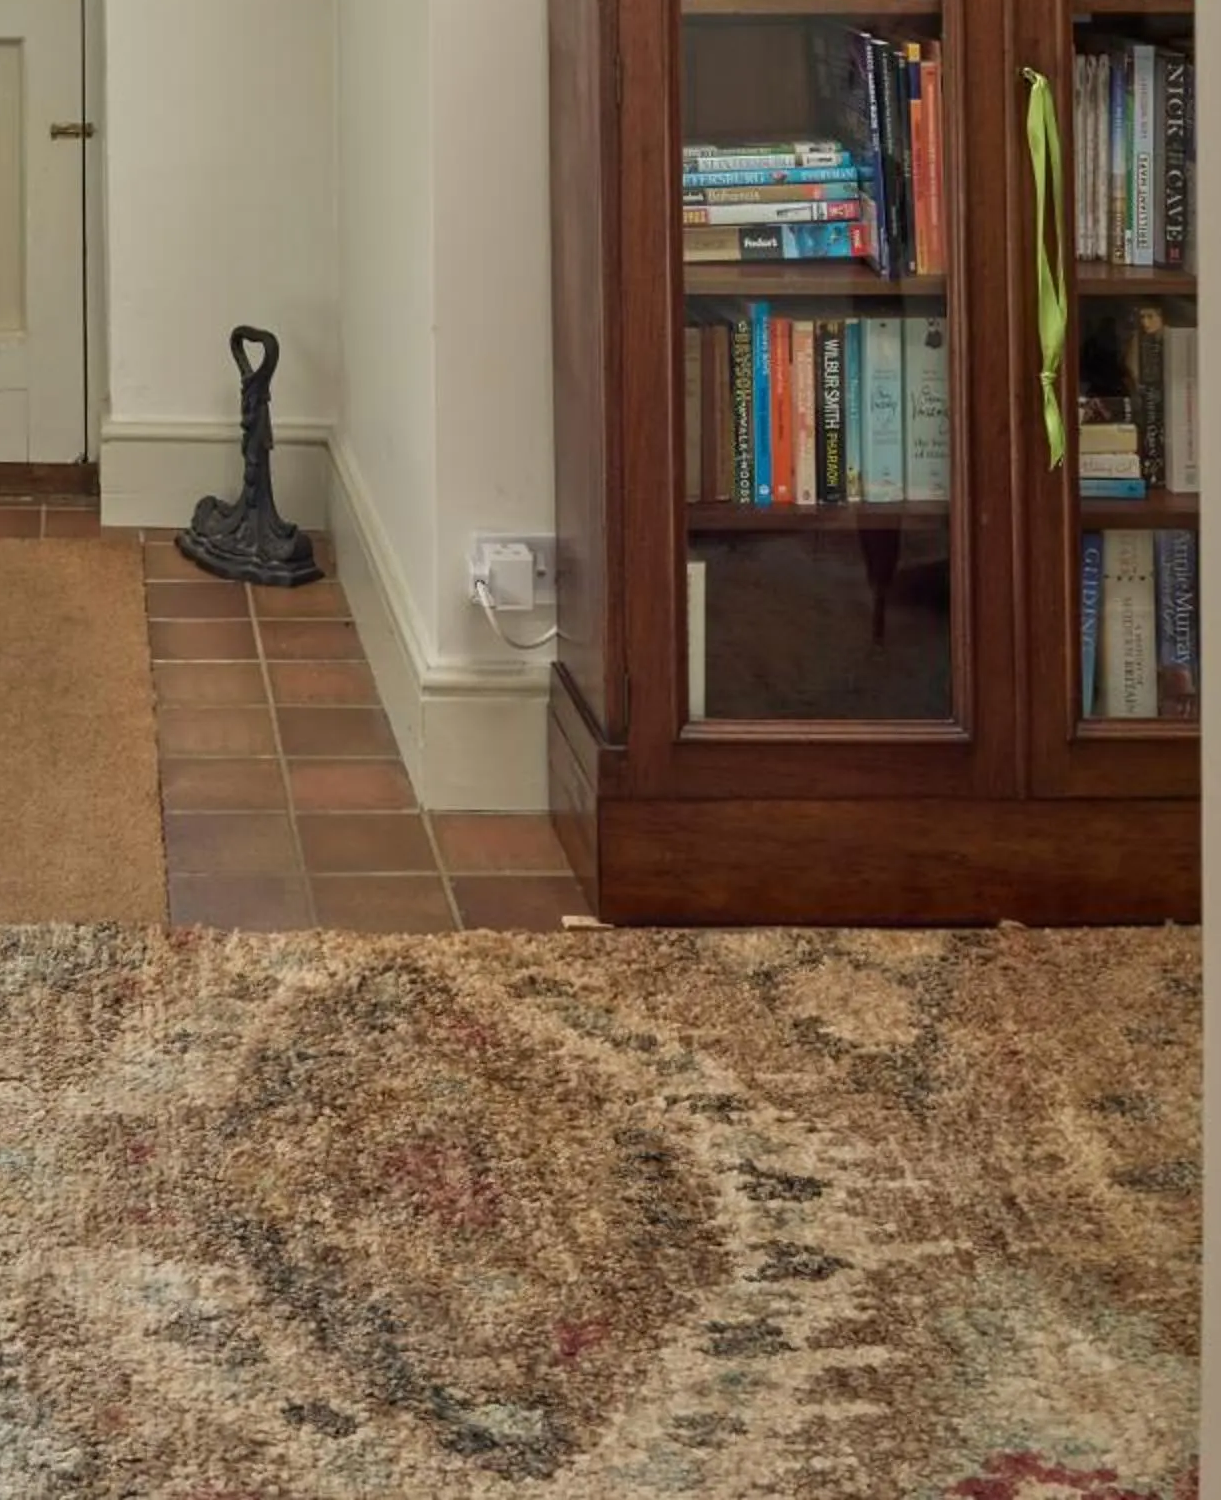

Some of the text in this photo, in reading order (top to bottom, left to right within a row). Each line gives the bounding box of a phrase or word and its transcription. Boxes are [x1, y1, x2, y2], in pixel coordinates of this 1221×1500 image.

[1138, 156, 1149, 187] MAPS
[1165, 63, 1185, 242] NICK CAVE
[1138, 190, 1149, 247] BRILLIANT
[734, 332, 753, 504] BRYSON WALK WOODS
[824, 338, 840, 487] WILBUR SMITH PHARAOH
[1122, 596, 1138, 714] MODERN BRITAIN
[1170, 593, 1194, 666] Murray
